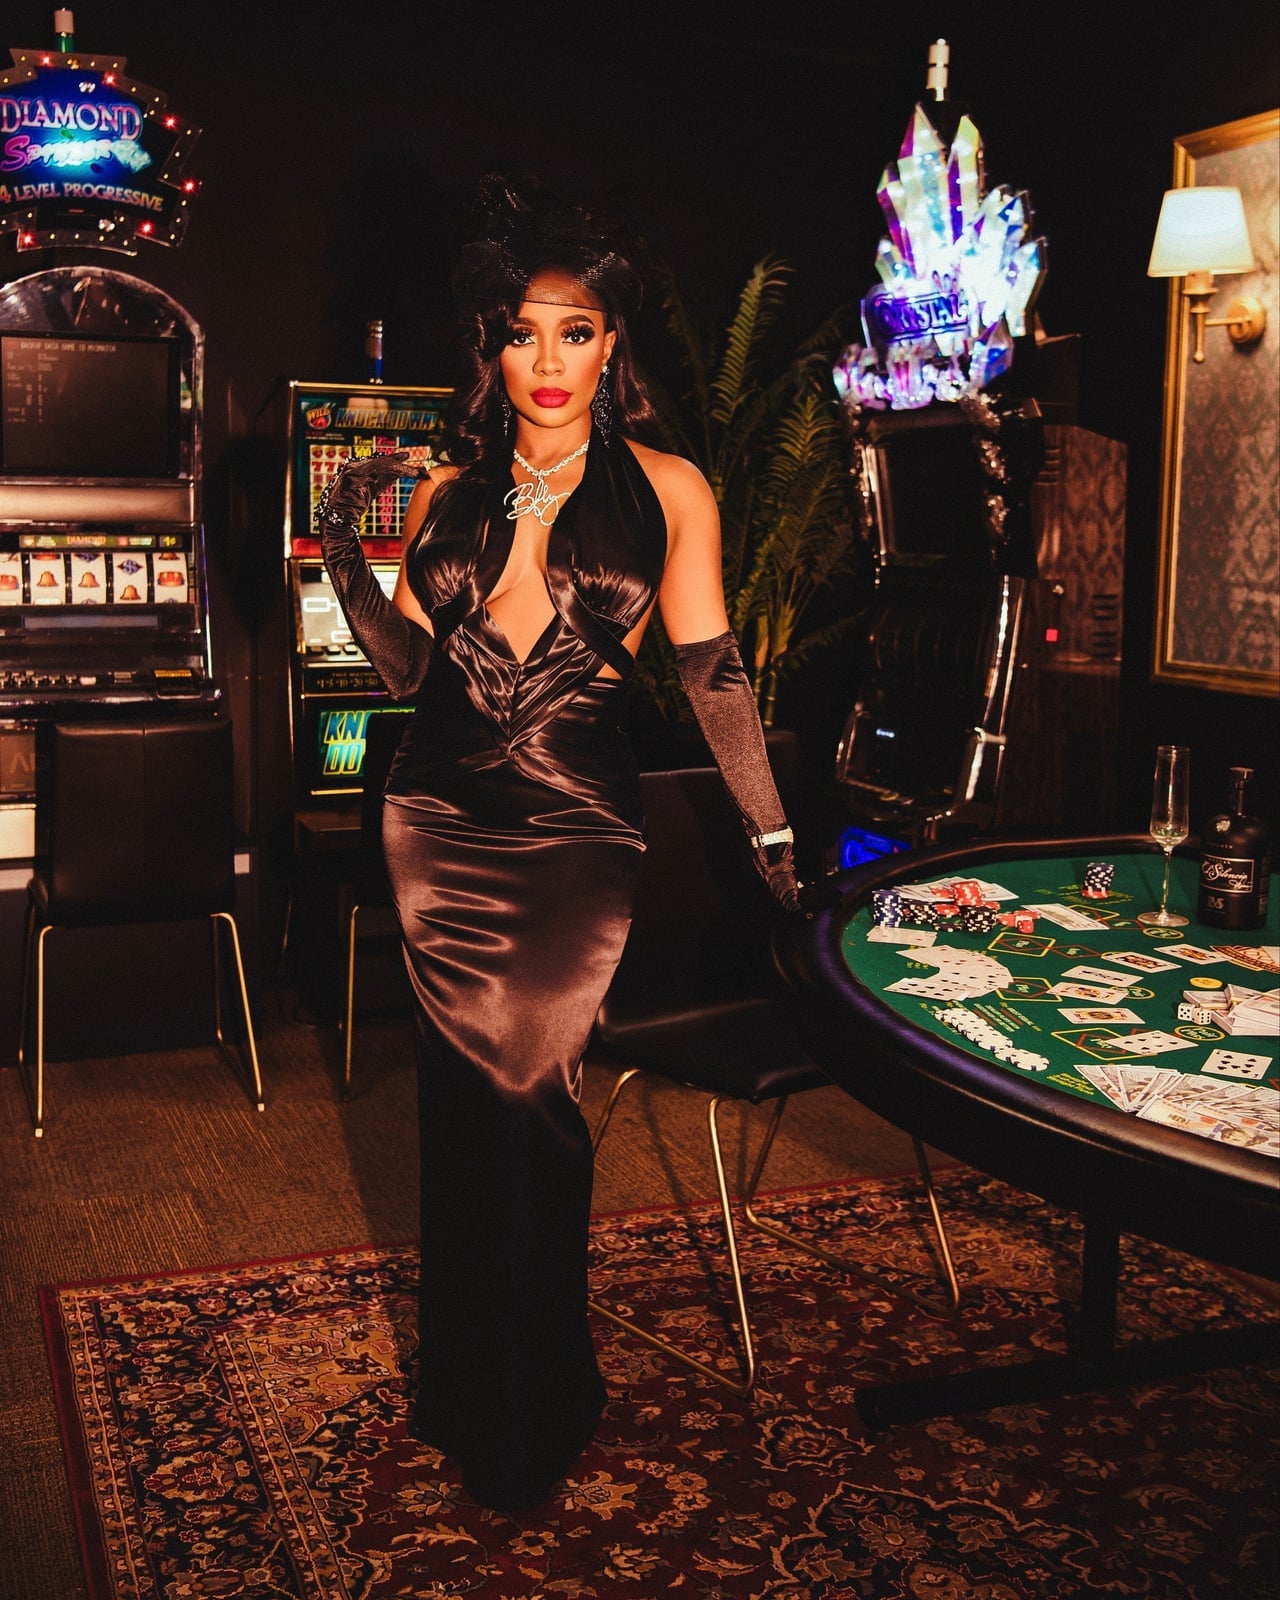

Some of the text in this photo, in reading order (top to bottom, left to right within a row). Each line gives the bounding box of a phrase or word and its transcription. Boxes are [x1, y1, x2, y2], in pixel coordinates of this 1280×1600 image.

[0, 98, 140, 141] DIAMOND
[13, 183, 60, 201] LEVEL
[64, 182, 164, 212] PROGRESSIVE
